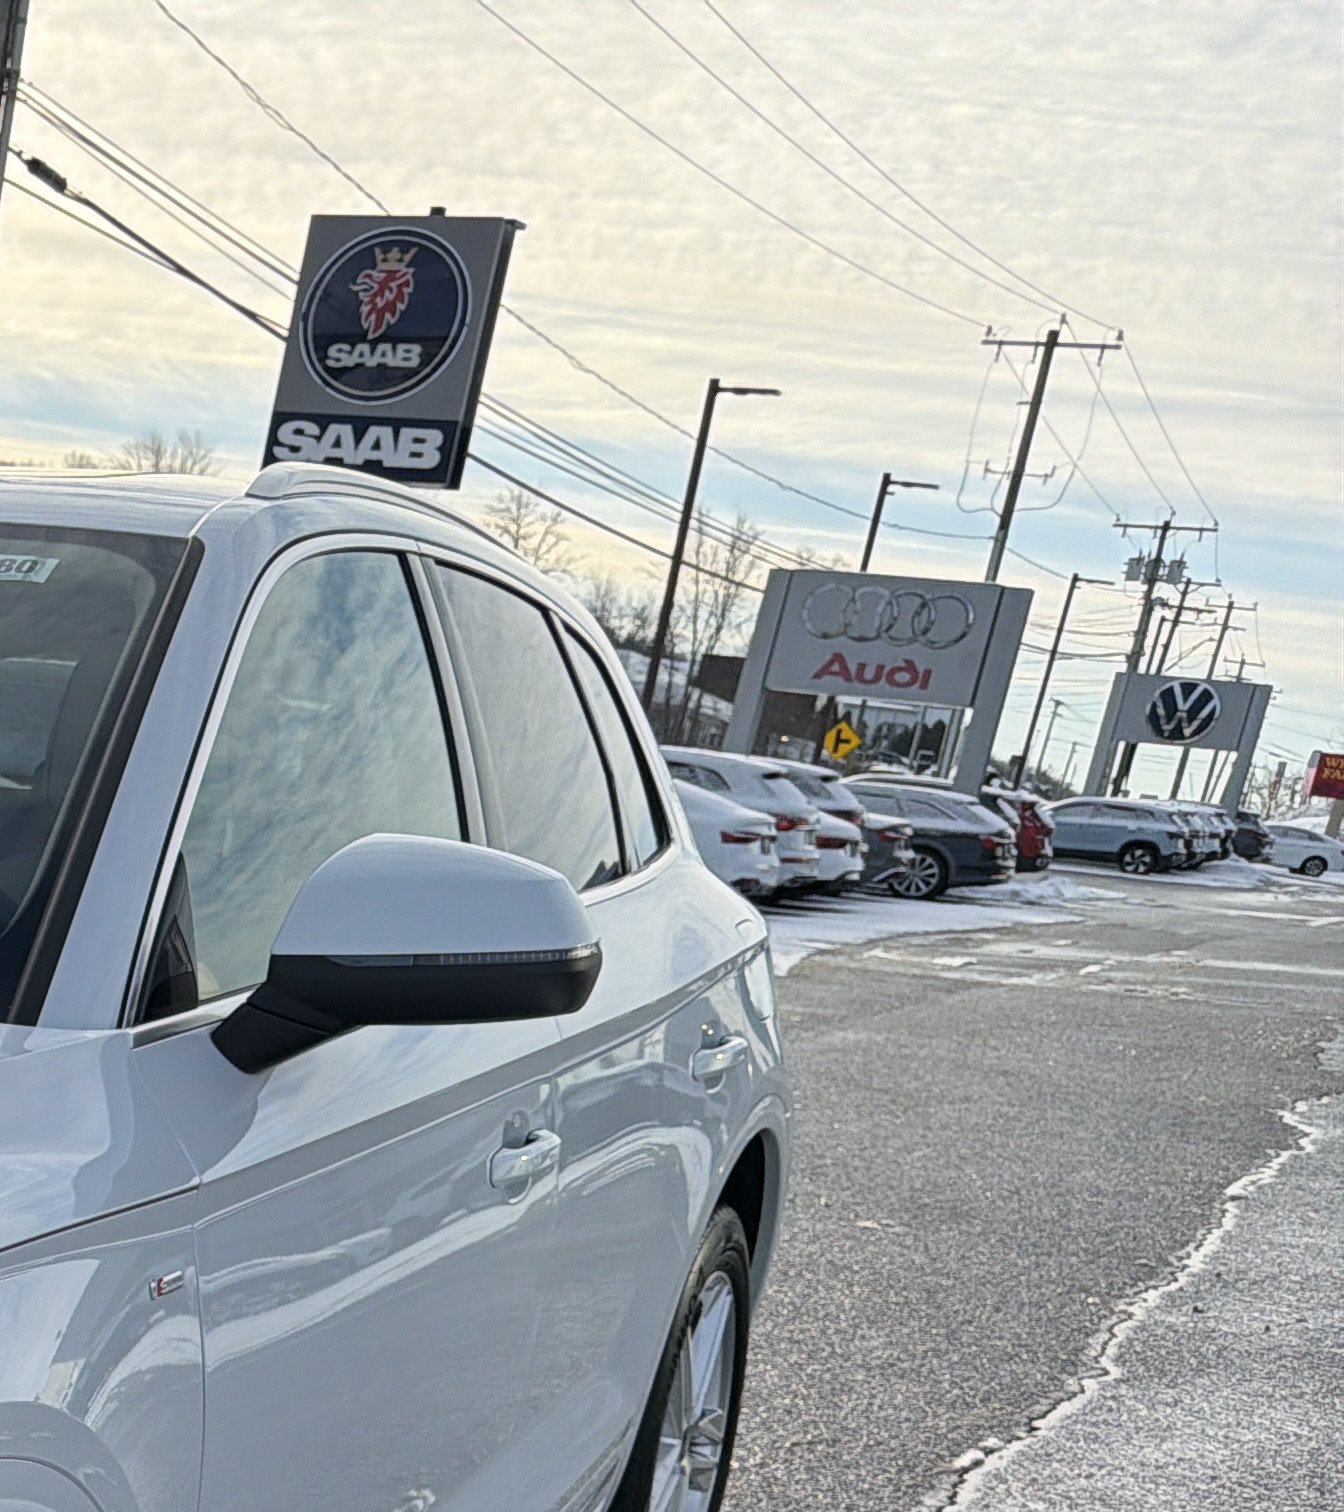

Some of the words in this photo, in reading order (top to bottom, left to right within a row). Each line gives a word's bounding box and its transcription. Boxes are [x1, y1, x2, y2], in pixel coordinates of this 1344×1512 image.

[325, 343, 422, 368] SAAB
[272, 420, 444, 470] SAAB
[811, 652, 932, 690] Audi
